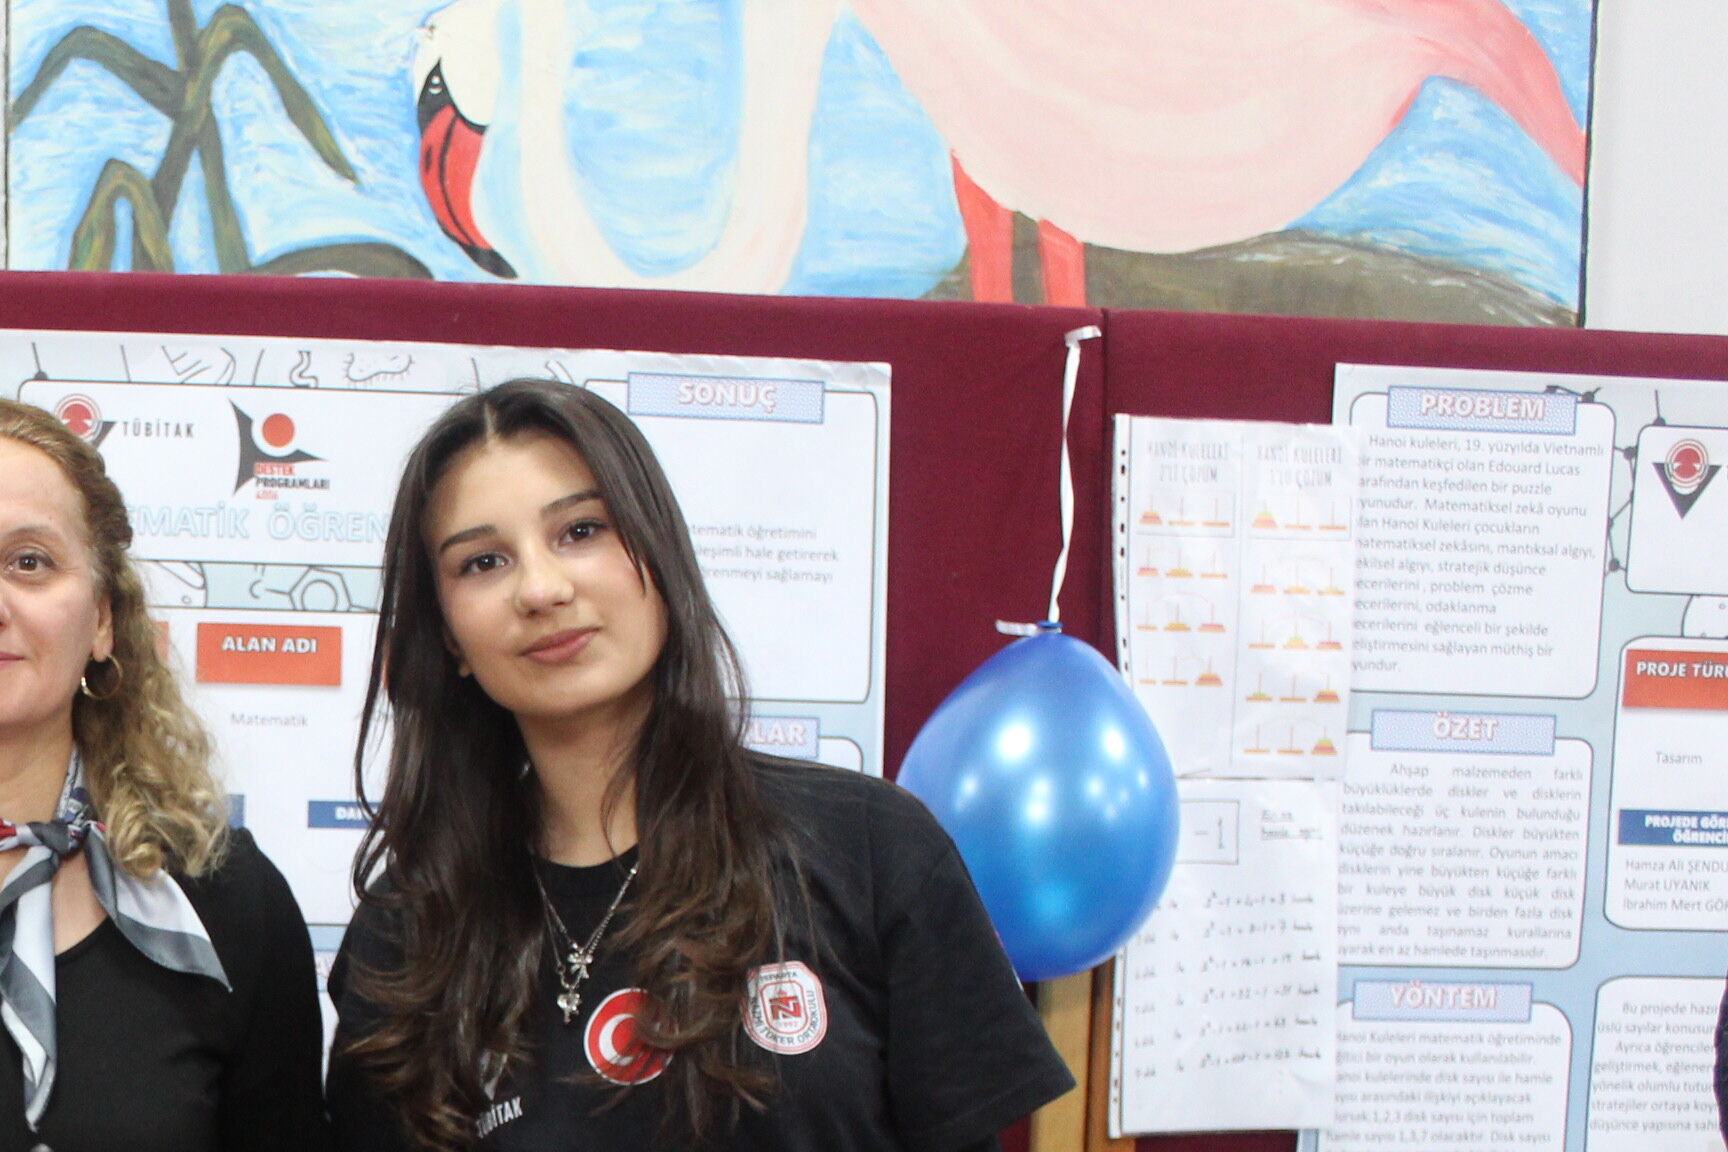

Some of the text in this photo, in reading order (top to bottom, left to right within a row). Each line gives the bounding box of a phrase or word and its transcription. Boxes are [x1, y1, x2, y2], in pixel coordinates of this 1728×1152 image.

[678, 382, 776, 414] SONUÇ
[1420, 395, 1547, 420] PROBLEM
[123, 421, 193, 439] TÜBİTAK
[1369, 436, 1406, 448] Hanoi
[1457, 460, 1484, 472] olan
[1489, 461, 1541, 474] Edouard
[1546, 464, 1580, 476] Lucas
[222, 636, 318, 654] ALAN ADI
[1636, 661, 1686, 677] PROJE
[231, 712, 308, 727] Matematik
[1434, 713, 1499, 740] ÖZET
[1656, 751, 1702, 765] Tasarım
[1390, 980, 1499, 1009] YÖNTEM
